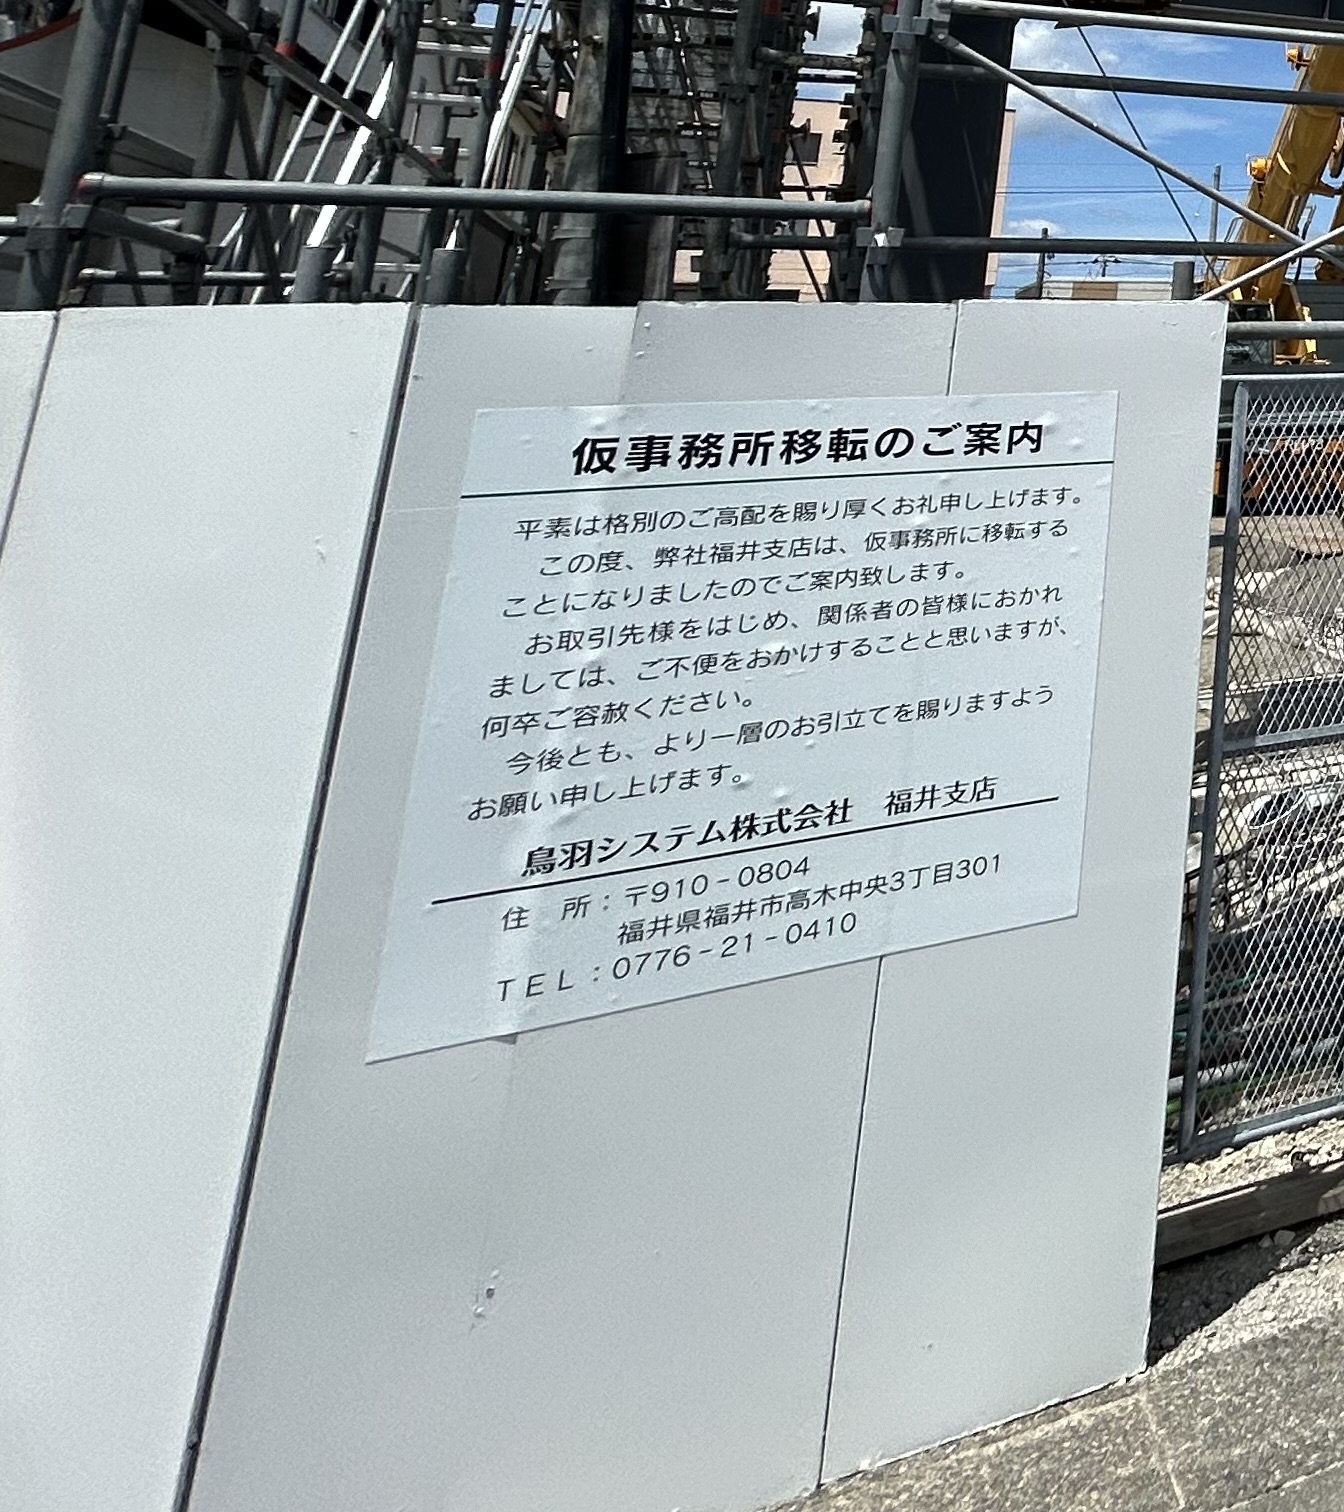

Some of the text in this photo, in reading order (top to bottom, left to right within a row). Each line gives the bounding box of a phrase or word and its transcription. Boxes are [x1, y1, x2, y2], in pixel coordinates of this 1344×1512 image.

[572, 420, 1044, 476] 仮事務所移転のご案内
[513, 487, 1083, 542] 平素は格別のご高配を賜り厚くお礼申し上げます。
[539, 519, 1069, 577] この度、弊社福井支店は、仮事務所に移転する
[501, 560, 966, 619] ことになりましたのでご案内致します。
[524, 584, 1064, 656] お取引先様をはじめ、関係者の皆様におかれ
[488, 616, 1068, 699] ましては、ご不便をおかけすることと思いますが、
[481, 689, 754, 741] 何卒ご容赦ください。
[505, 684, 1055, 776] 今後とも、より一層のお引立てを賜りますよう
[467, 763, 744, 821] お願い申し上げます。
[520, 776, 999, 877] 鳥羽システム株式会社 福井支店
[616, 854, 1002, 946] 福井県福井市高木中央3丁目301
